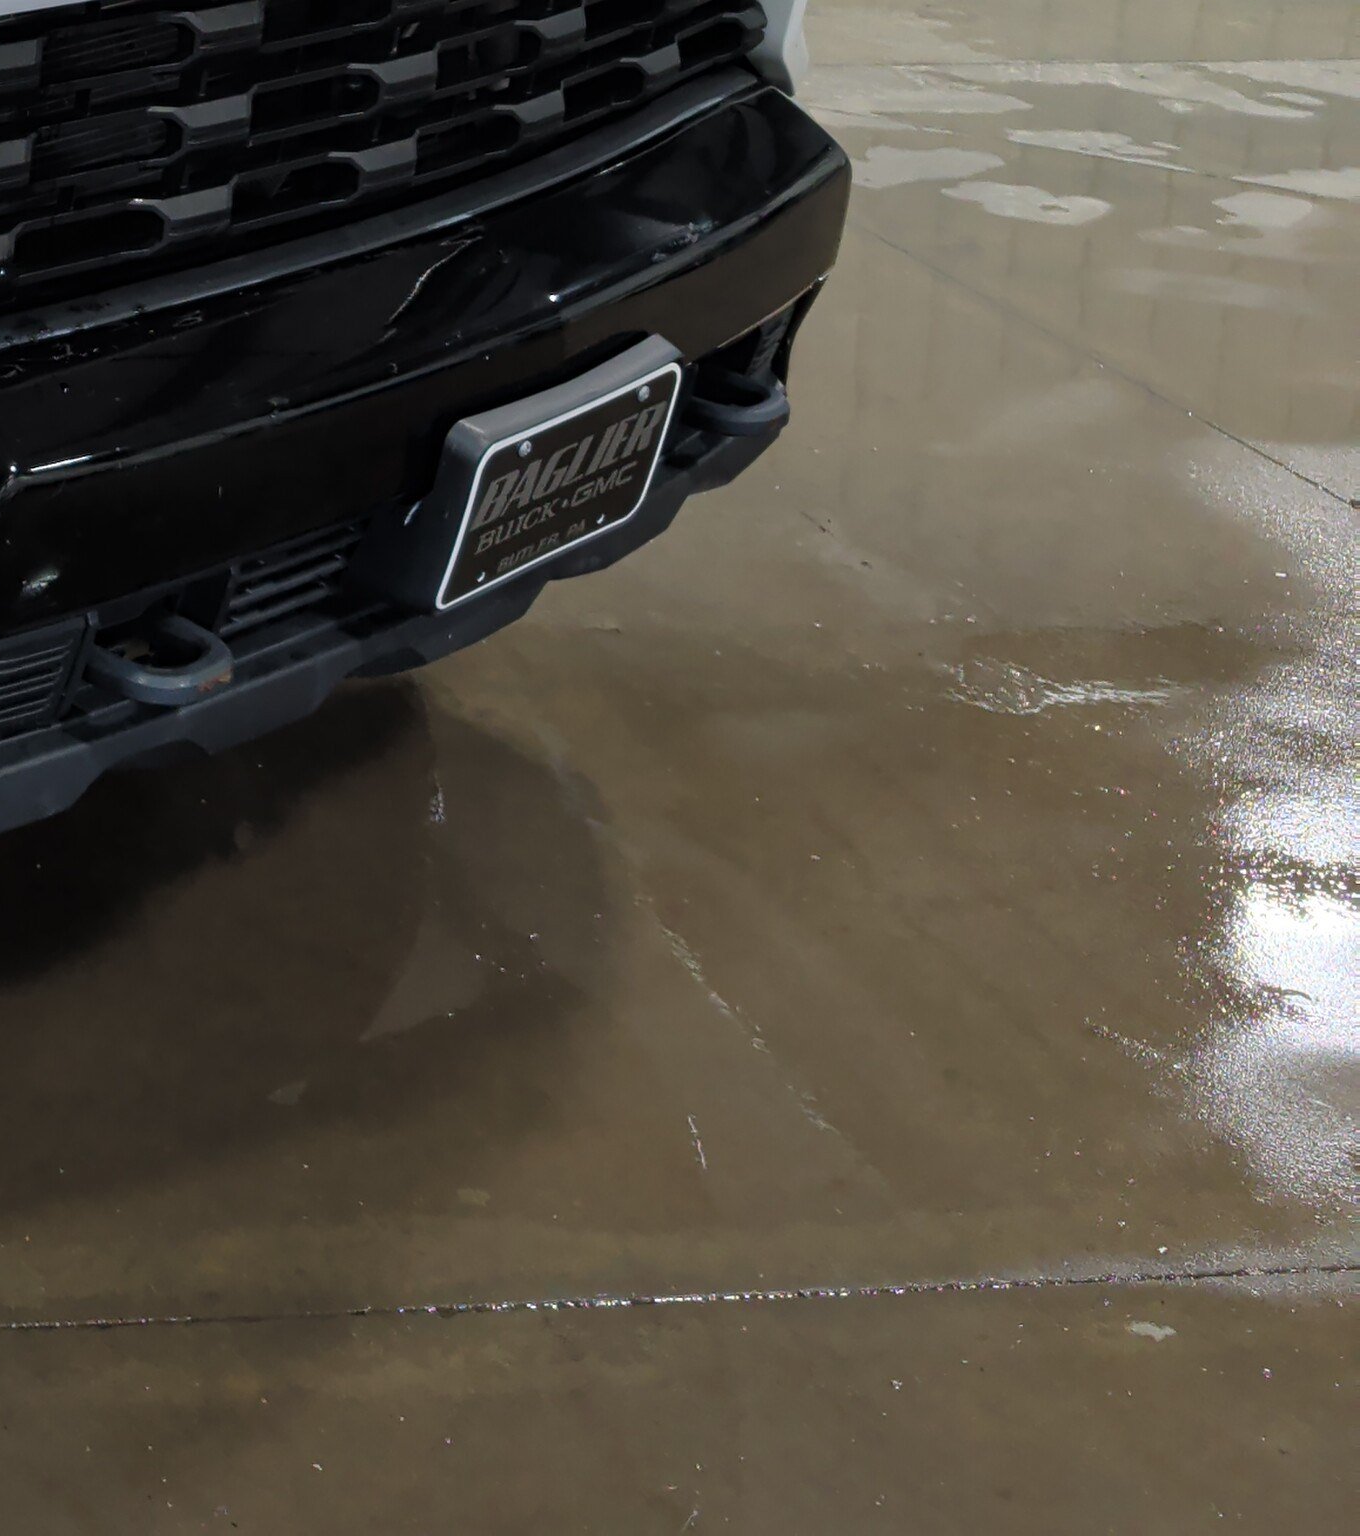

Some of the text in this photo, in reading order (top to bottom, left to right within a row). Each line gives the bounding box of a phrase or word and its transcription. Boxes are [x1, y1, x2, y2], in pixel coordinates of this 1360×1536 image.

[470, 400, 668, 532] BAGLIER
[474, 460, 638, 555] BUICK GMC
